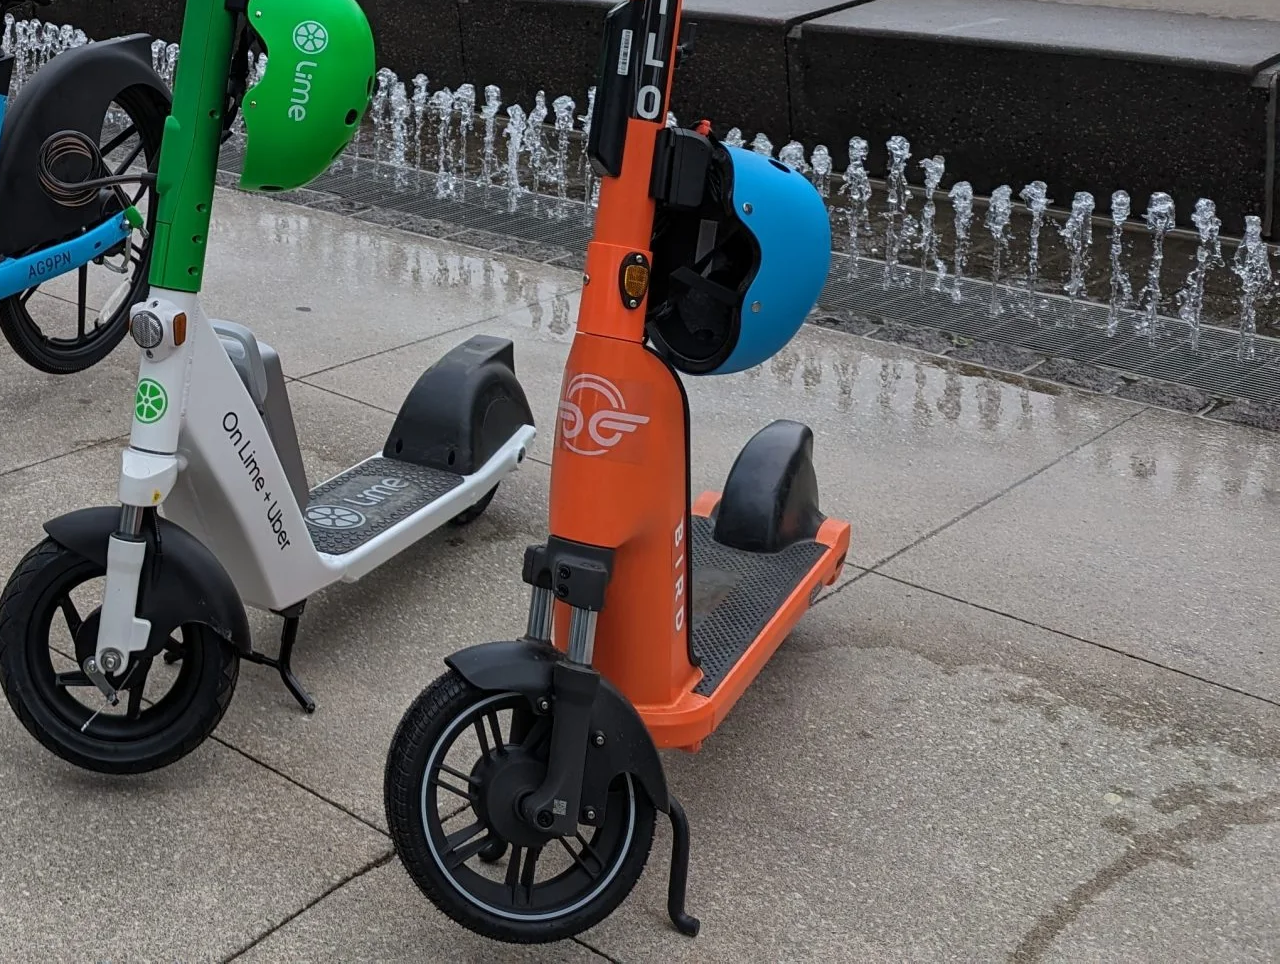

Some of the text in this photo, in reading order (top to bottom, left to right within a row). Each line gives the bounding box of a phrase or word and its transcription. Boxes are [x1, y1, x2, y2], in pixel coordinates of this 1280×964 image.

[288, 60, 318, 122] Lime
[28, 250, 72, 280] AG9PN
[222, 411, 291, 551] On Lime + Uber
[343, 477, 410, 507] Lime
[674, 516, 685, 632] BIRD
